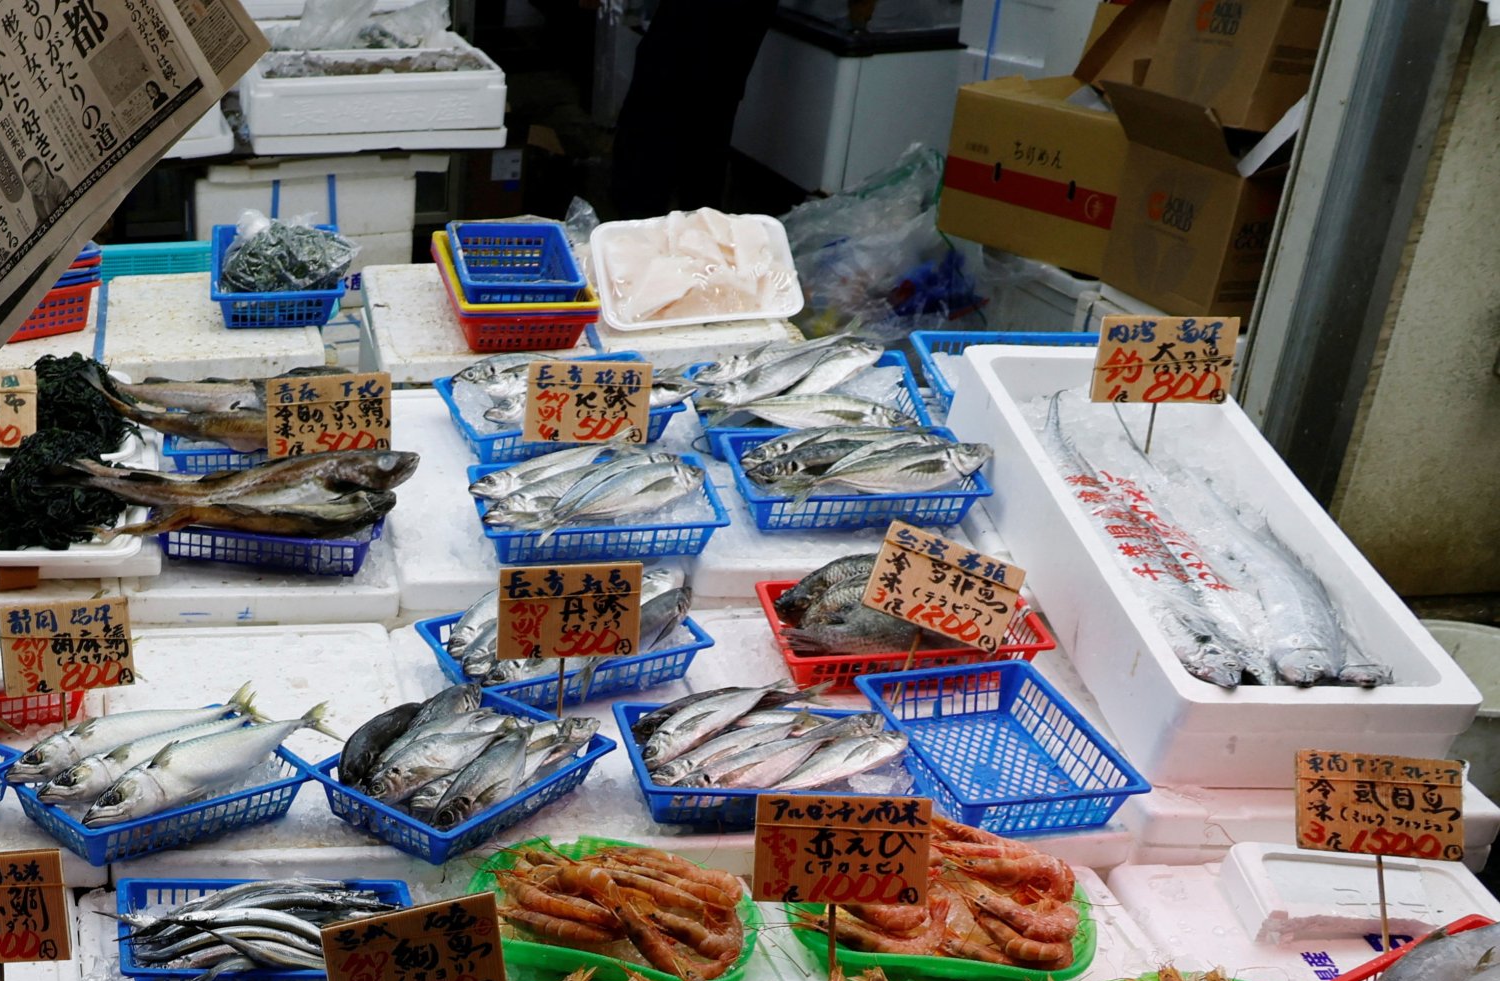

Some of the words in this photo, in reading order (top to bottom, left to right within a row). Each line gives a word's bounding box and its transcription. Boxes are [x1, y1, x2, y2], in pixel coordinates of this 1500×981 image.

[1214, 2, 1243, 18] AQUA
[1209, 18, 1239, 35] GOLD
[2, 9, 52, 98] 彬子女王
[1013, 140, 1063, 169] ちりめん
[1166, 190, 1194, 213] AQUA
[1162, 209, 1192, 233] GOLD
[1103, 347, 1143, 383] 釣
[274, 382, 320, 403] 青森
[1142, 370, 1226, 403] 800円
[274, 405, 295, 439] 冷凍
[912, 587, 992, 626] (テラピア)
[7, 609, 58, 634] 静岡
[553, 628, 632, 655] 500円
[60, 660, 133, 690] 800円
[1401, 765, 1459, 784] マレーシア
[803, 823, 924, 860] 赤えび
[804, 860, 904, 874] (アカエビ)
